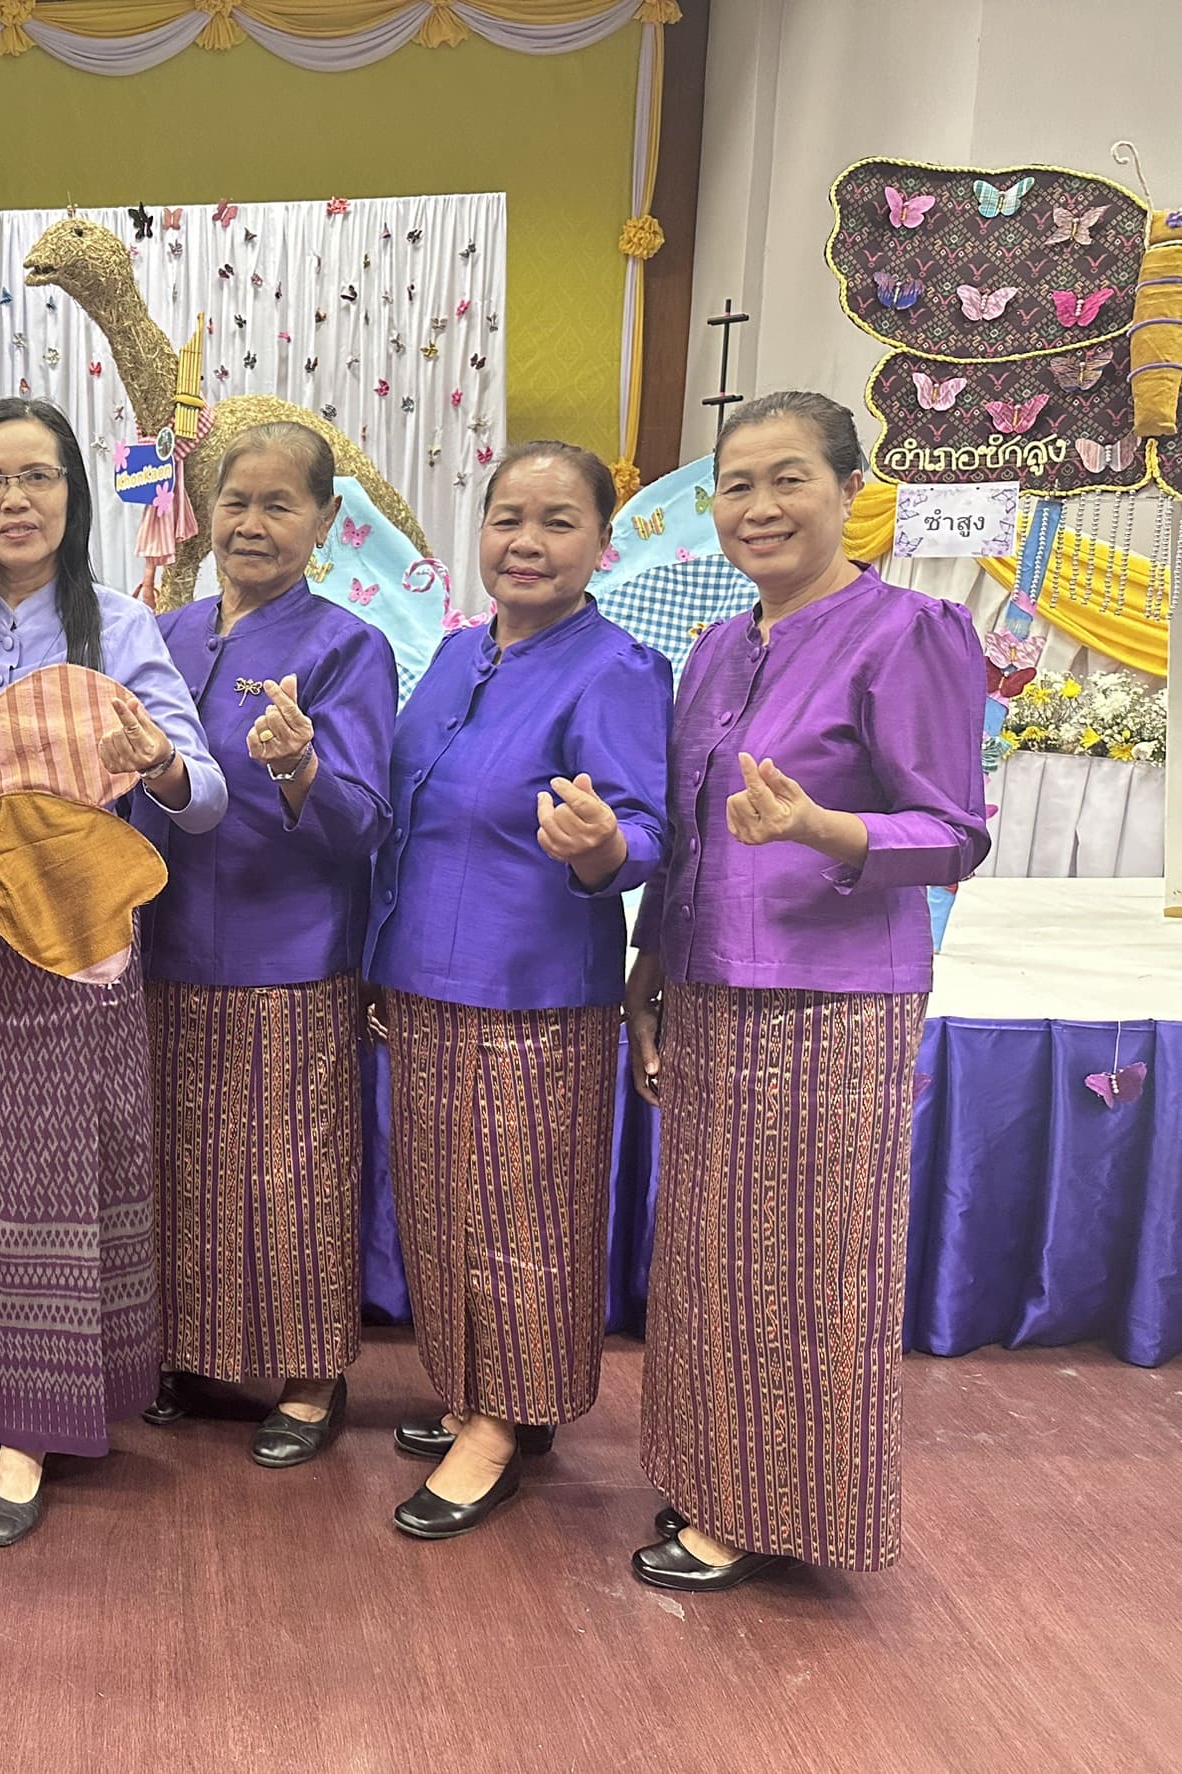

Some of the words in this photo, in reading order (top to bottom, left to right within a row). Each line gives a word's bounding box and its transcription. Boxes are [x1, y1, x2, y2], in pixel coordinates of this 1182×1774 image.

[884, 434, 1068, 476] อำเภอซำสูง
[924, 508, 985, 538] ซำสูง
